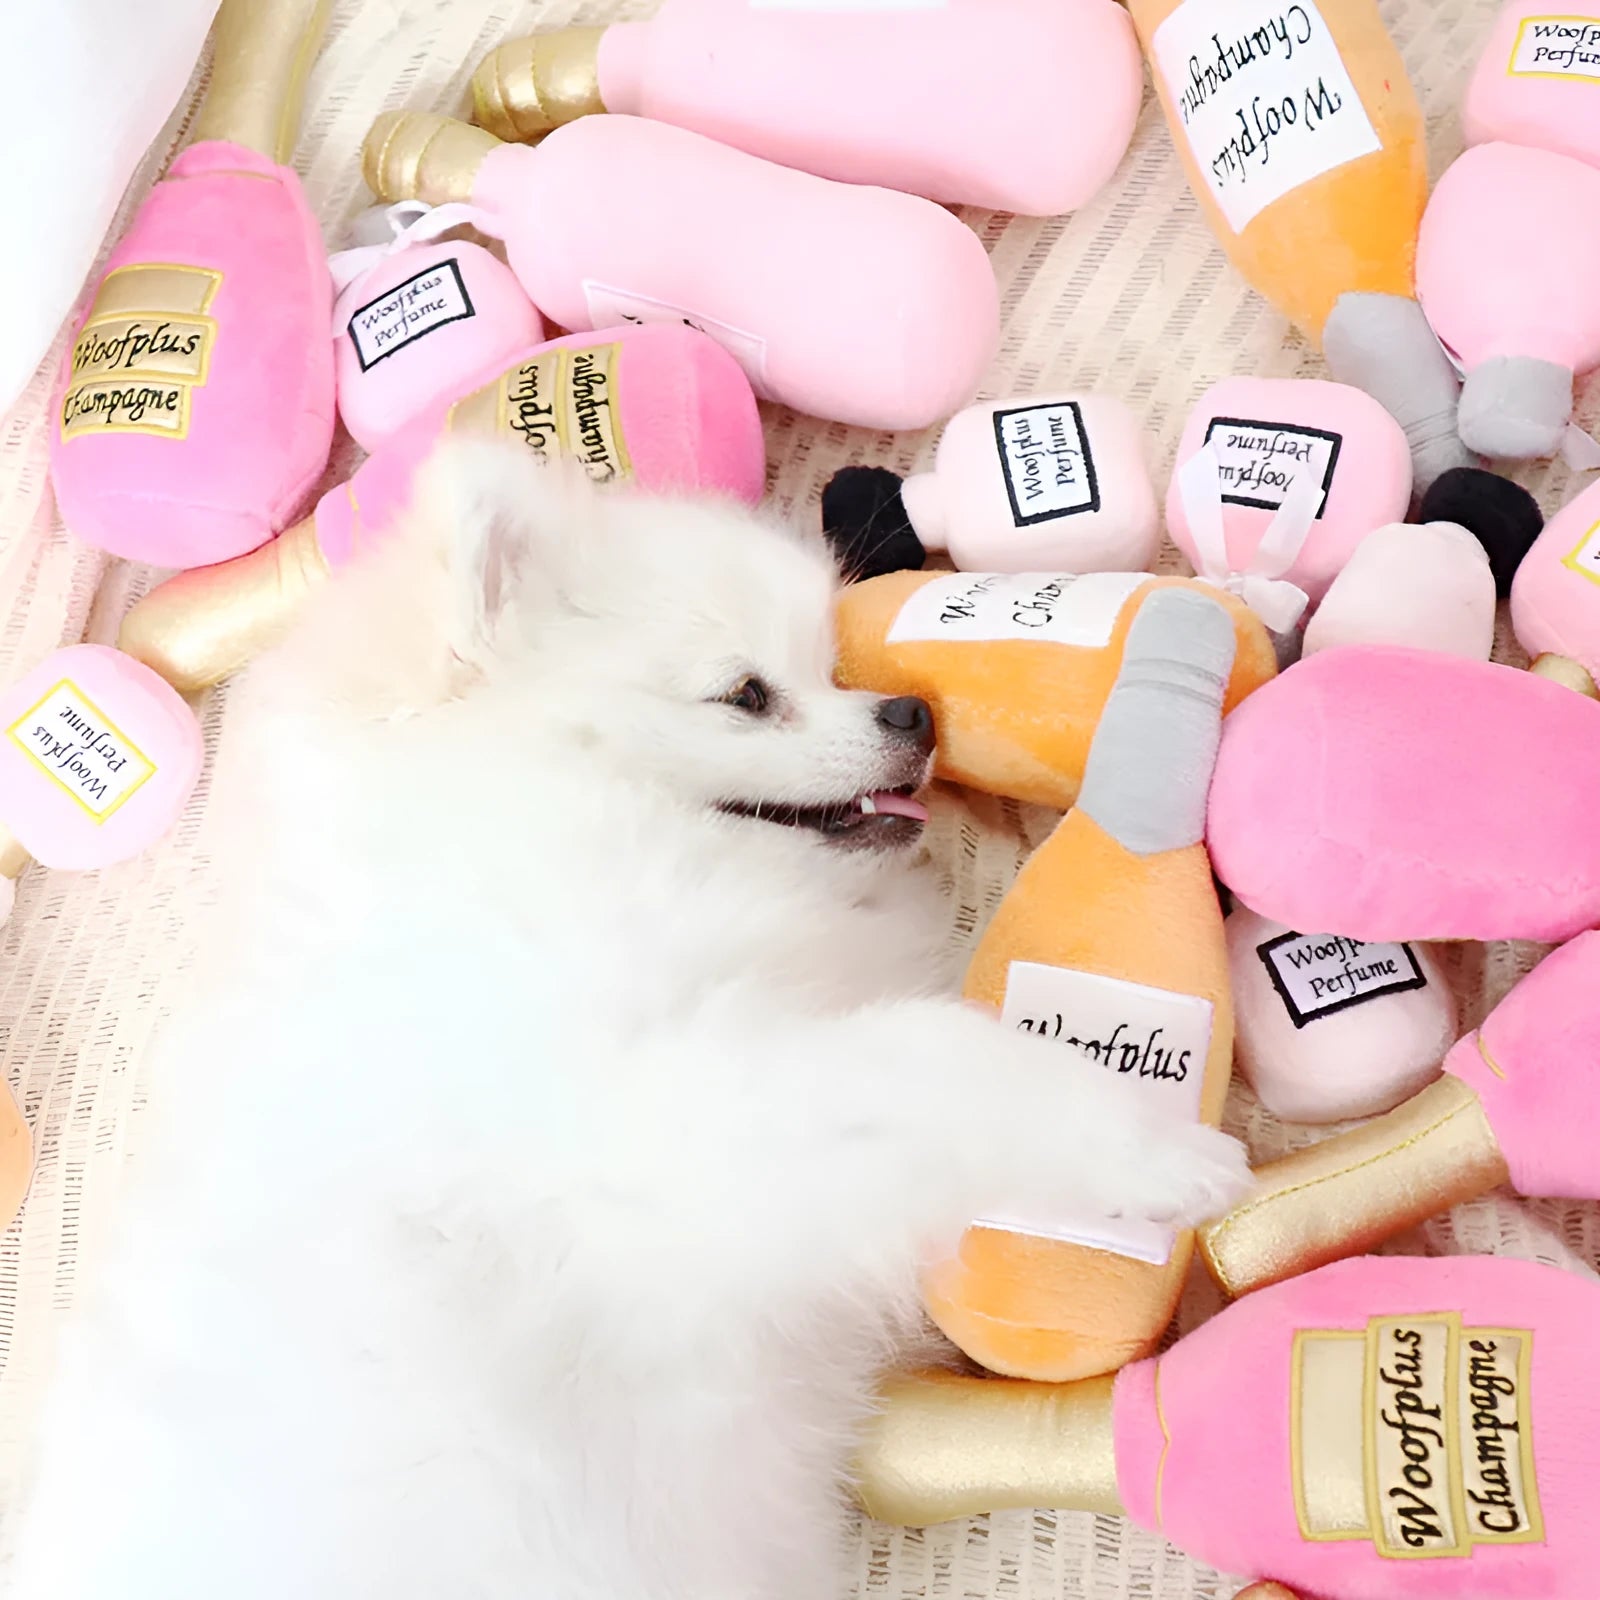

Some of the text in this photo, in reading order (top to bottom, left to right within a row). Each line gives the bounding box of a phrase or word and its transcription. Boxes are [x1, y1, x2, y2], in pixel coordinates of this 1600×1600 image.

[32, 726, 108, 800] Woofplus
[59, 705, 128, 773] Perfume
[1309, 962, 1399, 999] Perfume
[1380, 1328, 1444, 1547] Woofplus
[1467, 1339, 1520, 1533] Champagne
